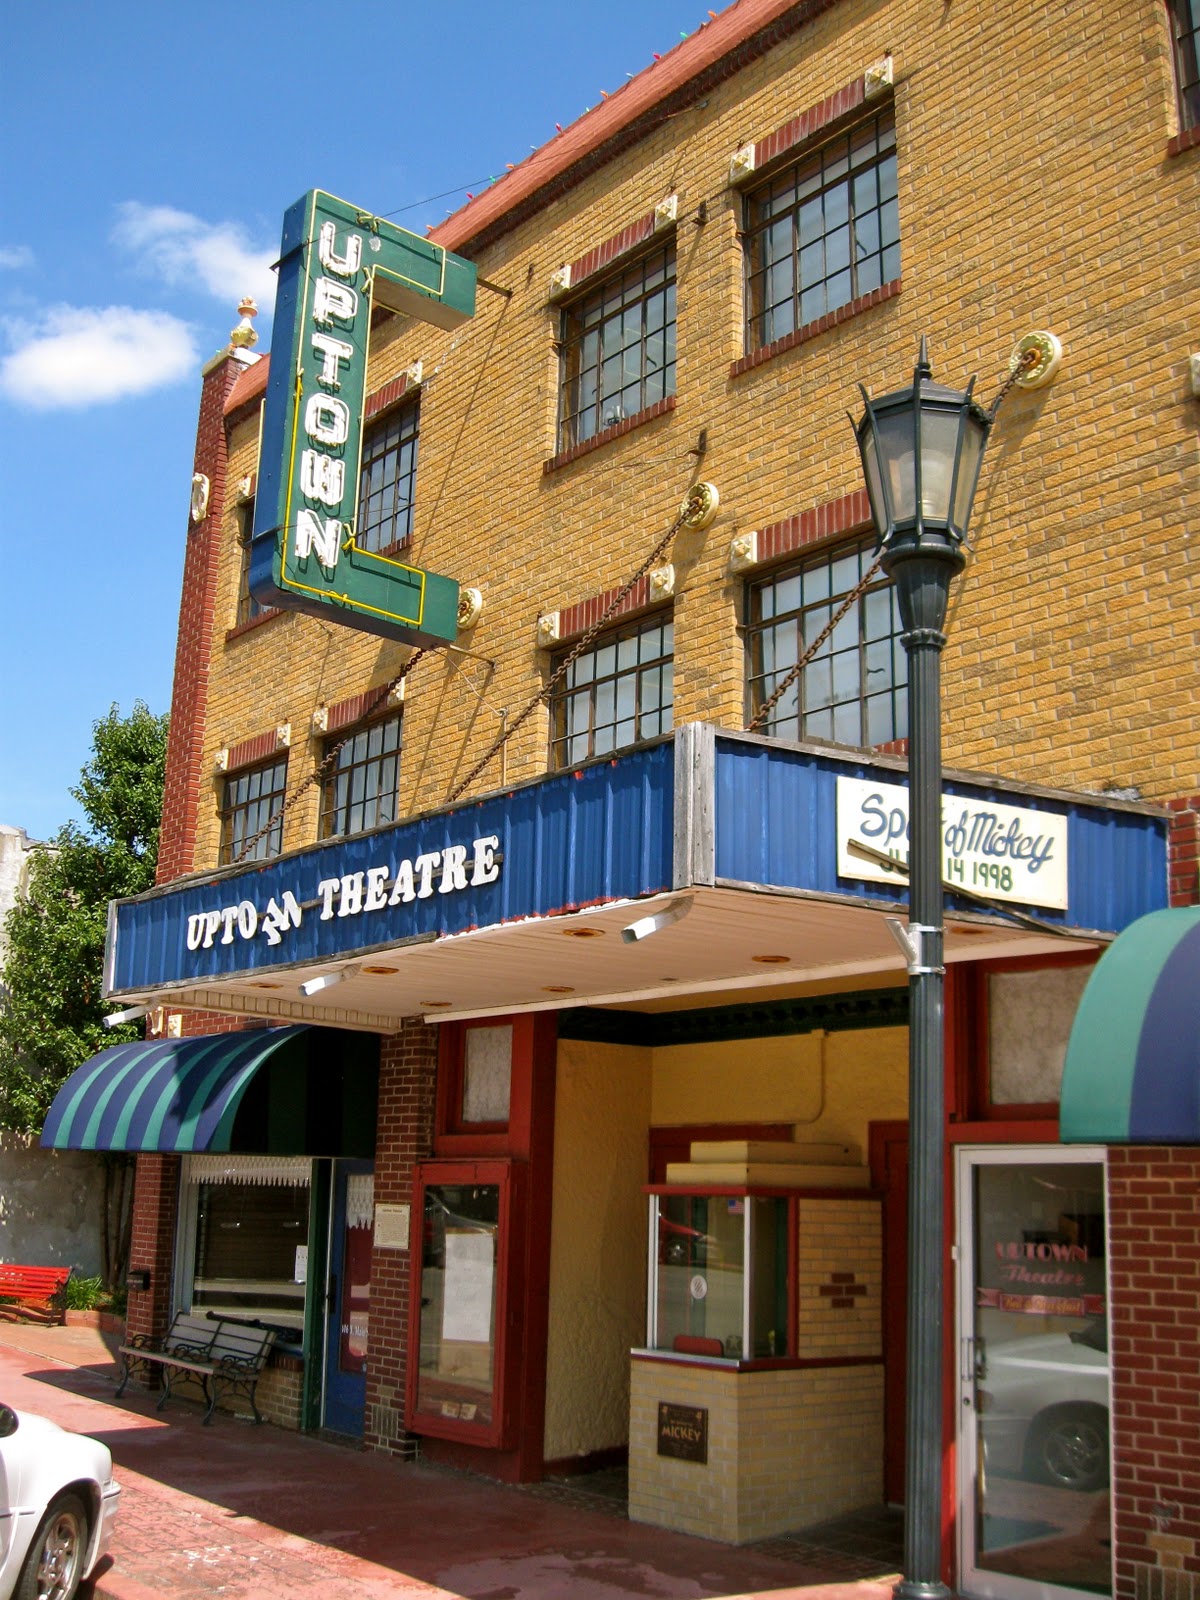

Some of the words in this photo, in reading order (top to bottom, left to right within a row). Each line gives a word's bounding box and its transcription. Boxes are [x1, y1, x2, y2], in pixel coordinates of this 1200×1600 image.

[294, 221, 362, 569] UPTOWN
[944, 809, 969, 858] of
[967, 811, 1056, 874] Mickey
[317, 834, 499, 921] THEATRE
[947, 856, 965, 883] 14
[972, 861, 1014, 893] 1998
[661, 1426, 701, 1442] MICKEY
